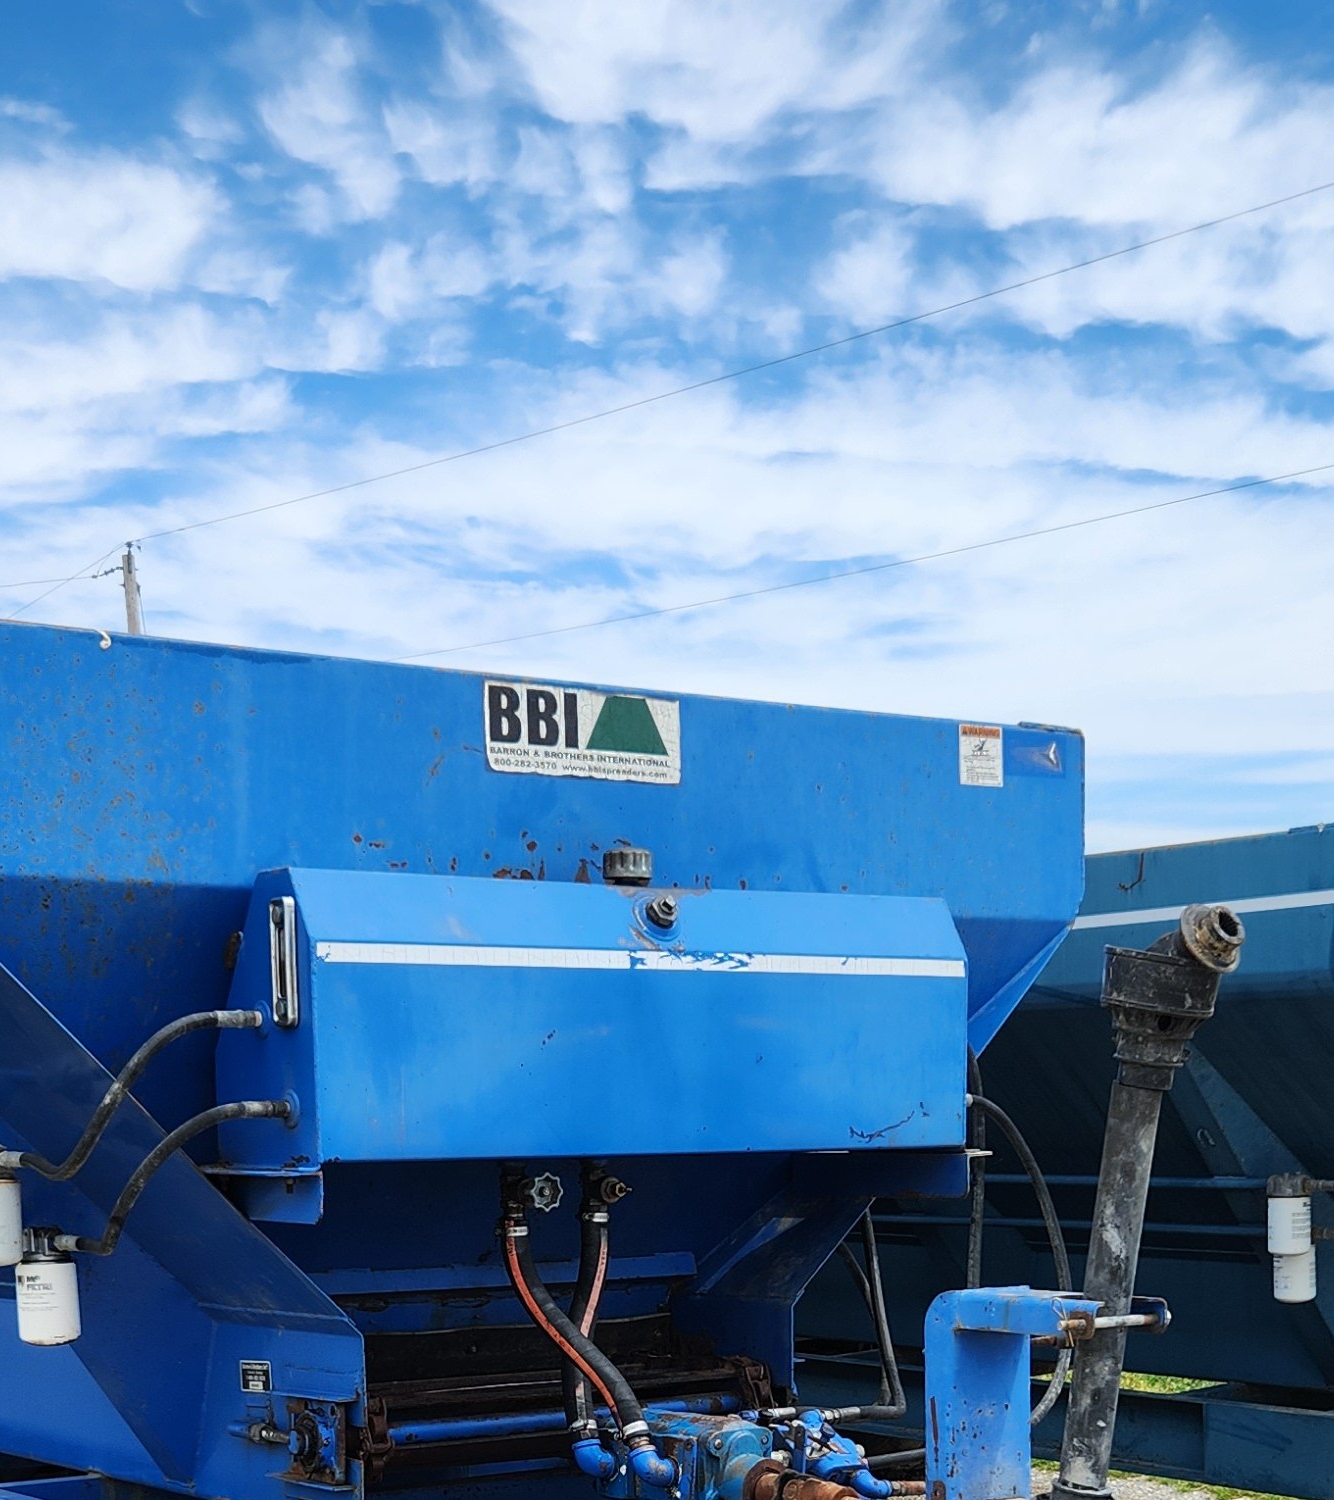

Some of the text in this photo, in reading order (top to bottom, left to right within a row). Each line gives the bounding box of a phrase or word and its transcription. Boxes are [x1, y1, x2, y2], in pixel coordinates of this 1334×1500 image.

[488, 684, 579, 750] BBI
[490, 746, 529, 757] BARRON
[544, 750, 594, 761] BROTHERS
[597, 754, 670, 768] INTERNATIONAL
